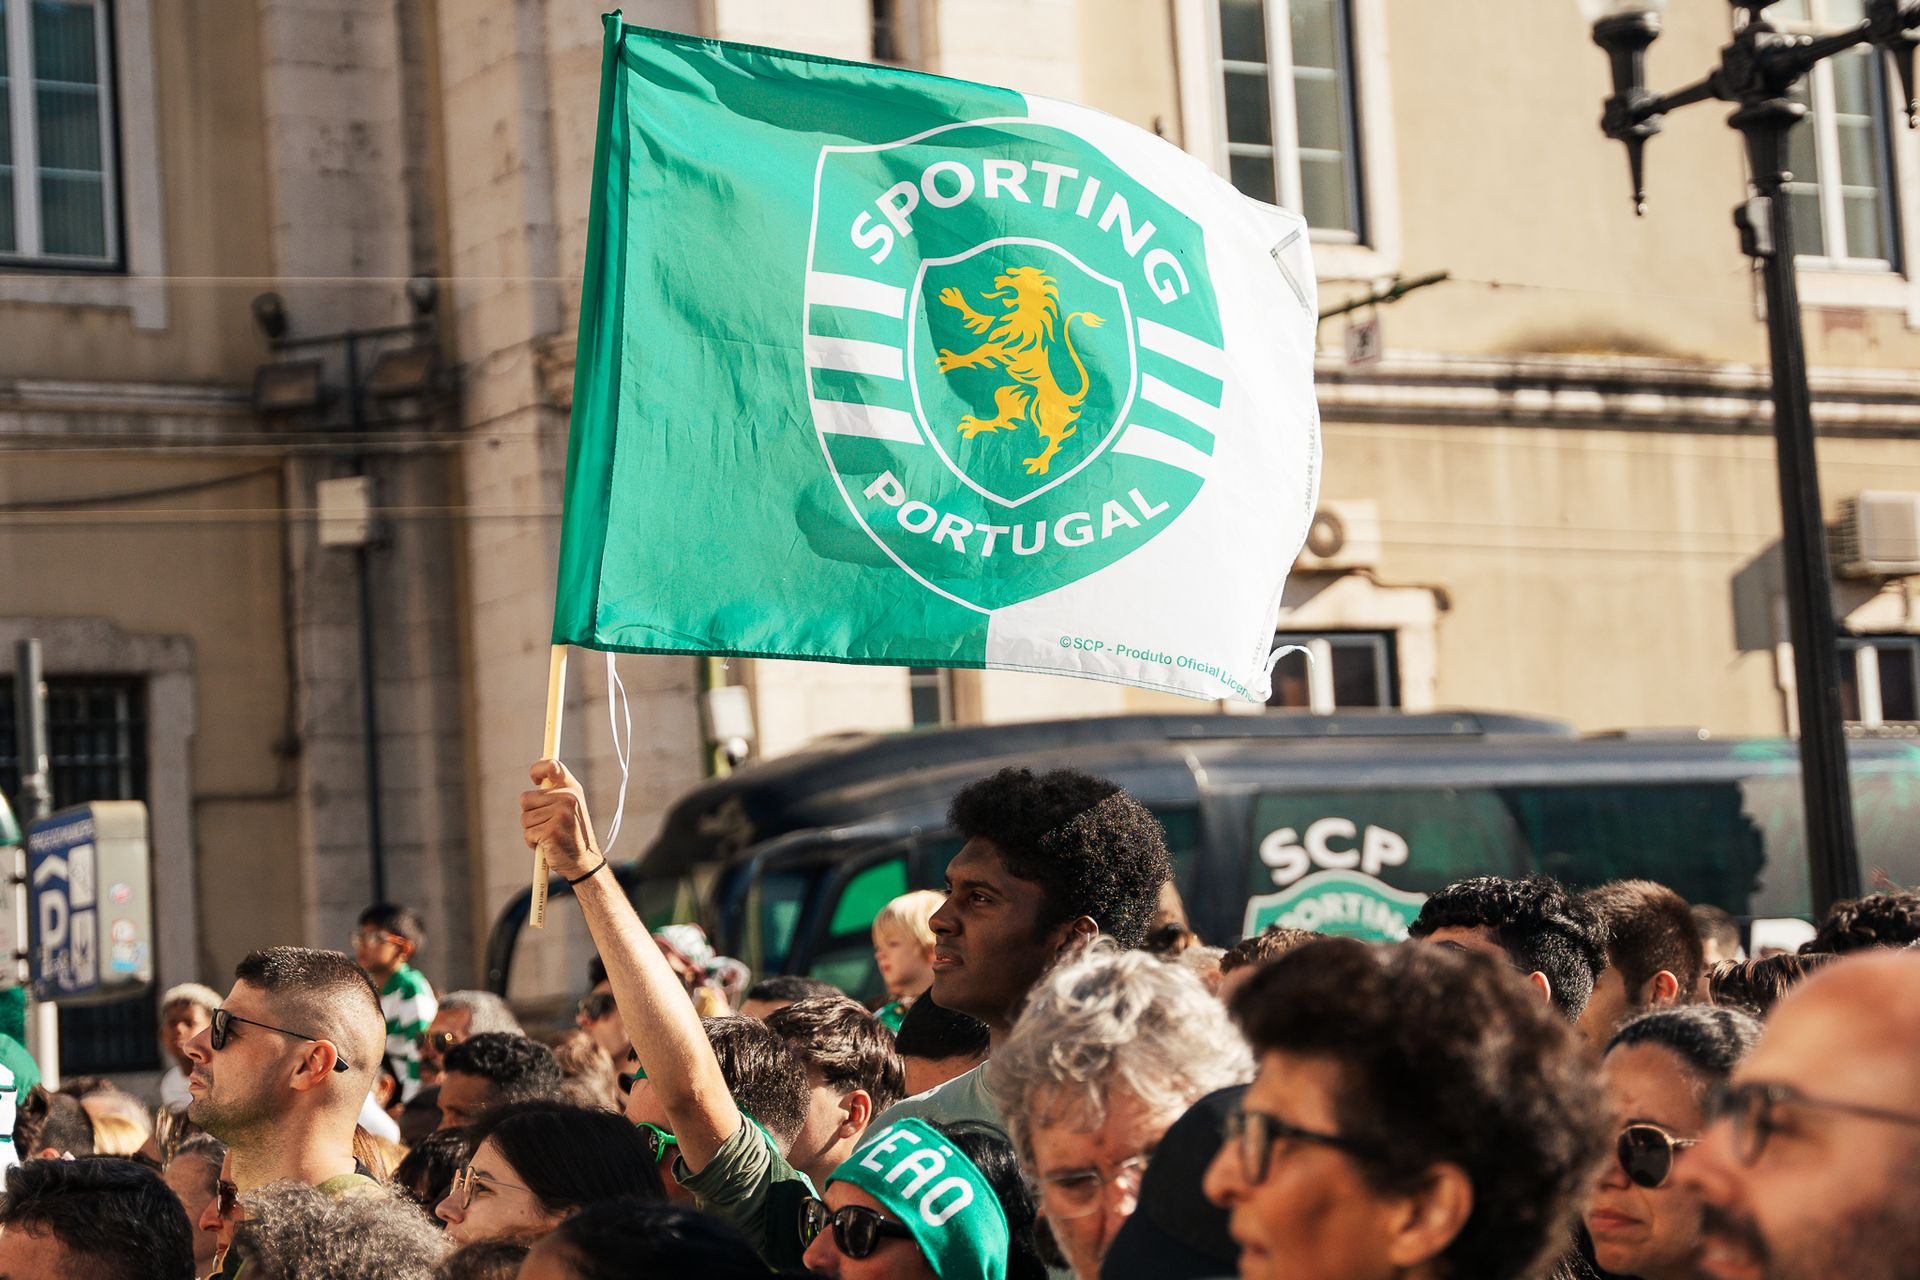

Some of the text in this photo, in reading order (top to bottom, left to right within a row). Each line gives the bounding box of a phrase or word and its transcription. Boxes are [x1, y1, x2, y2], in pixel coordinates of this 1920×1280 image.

[850, 159, 1190, 305] SPORTING
[863, 469, 1170, 557] PORTUGAL
[1116, 645, 1173, 665] Produto
[1176, 655, 1220, 678] Oficial
[1259, 817, 1409, 886] SCP
